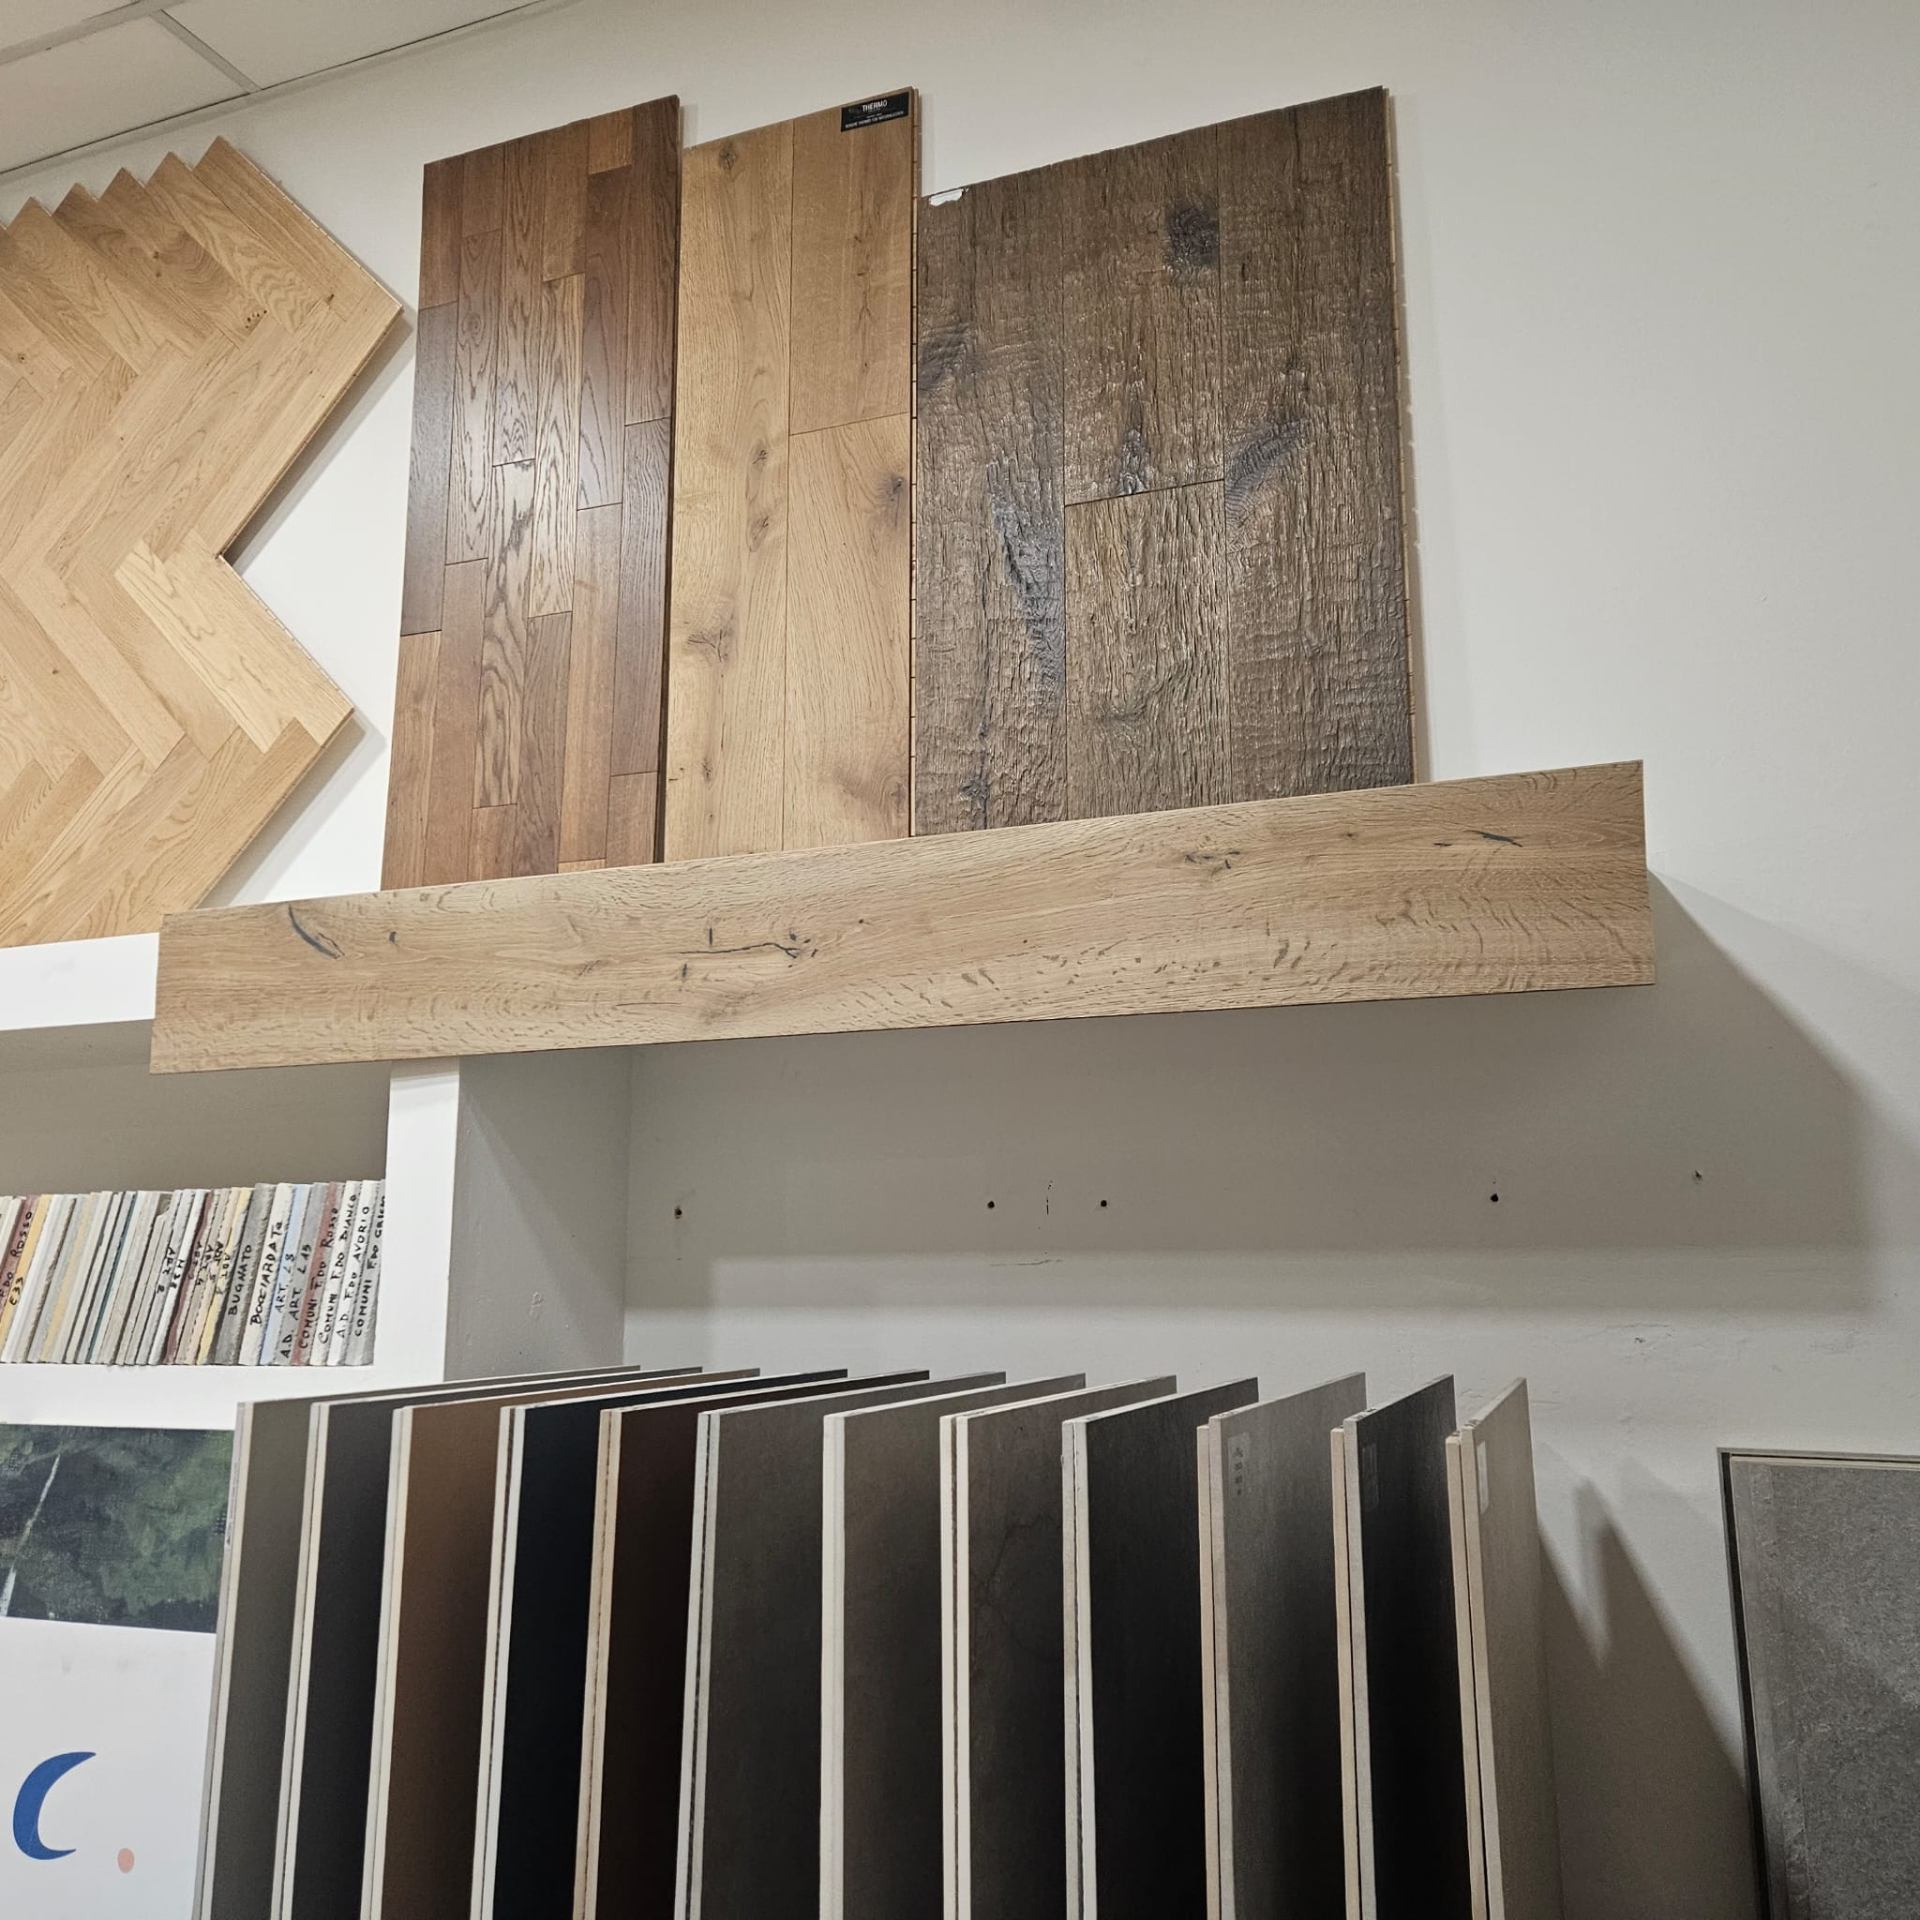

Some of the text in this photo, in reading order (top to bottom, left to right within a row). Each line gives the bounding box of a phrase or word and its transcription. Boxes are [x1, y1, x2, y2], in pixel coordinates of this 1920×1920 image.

[862, 100, 888, 112] THERMO
[10, 1211, 32, 1257] ROSSO
[352, 1206, 370, 1263] AVORIO
[227, 1244, 252, 1316] BUGNATO
[300, 1298, 317, 1349] COMUNI
[318, 1293, 338, 1344] COMUNI
[354, 1279, 373, 1337] COMUNI
